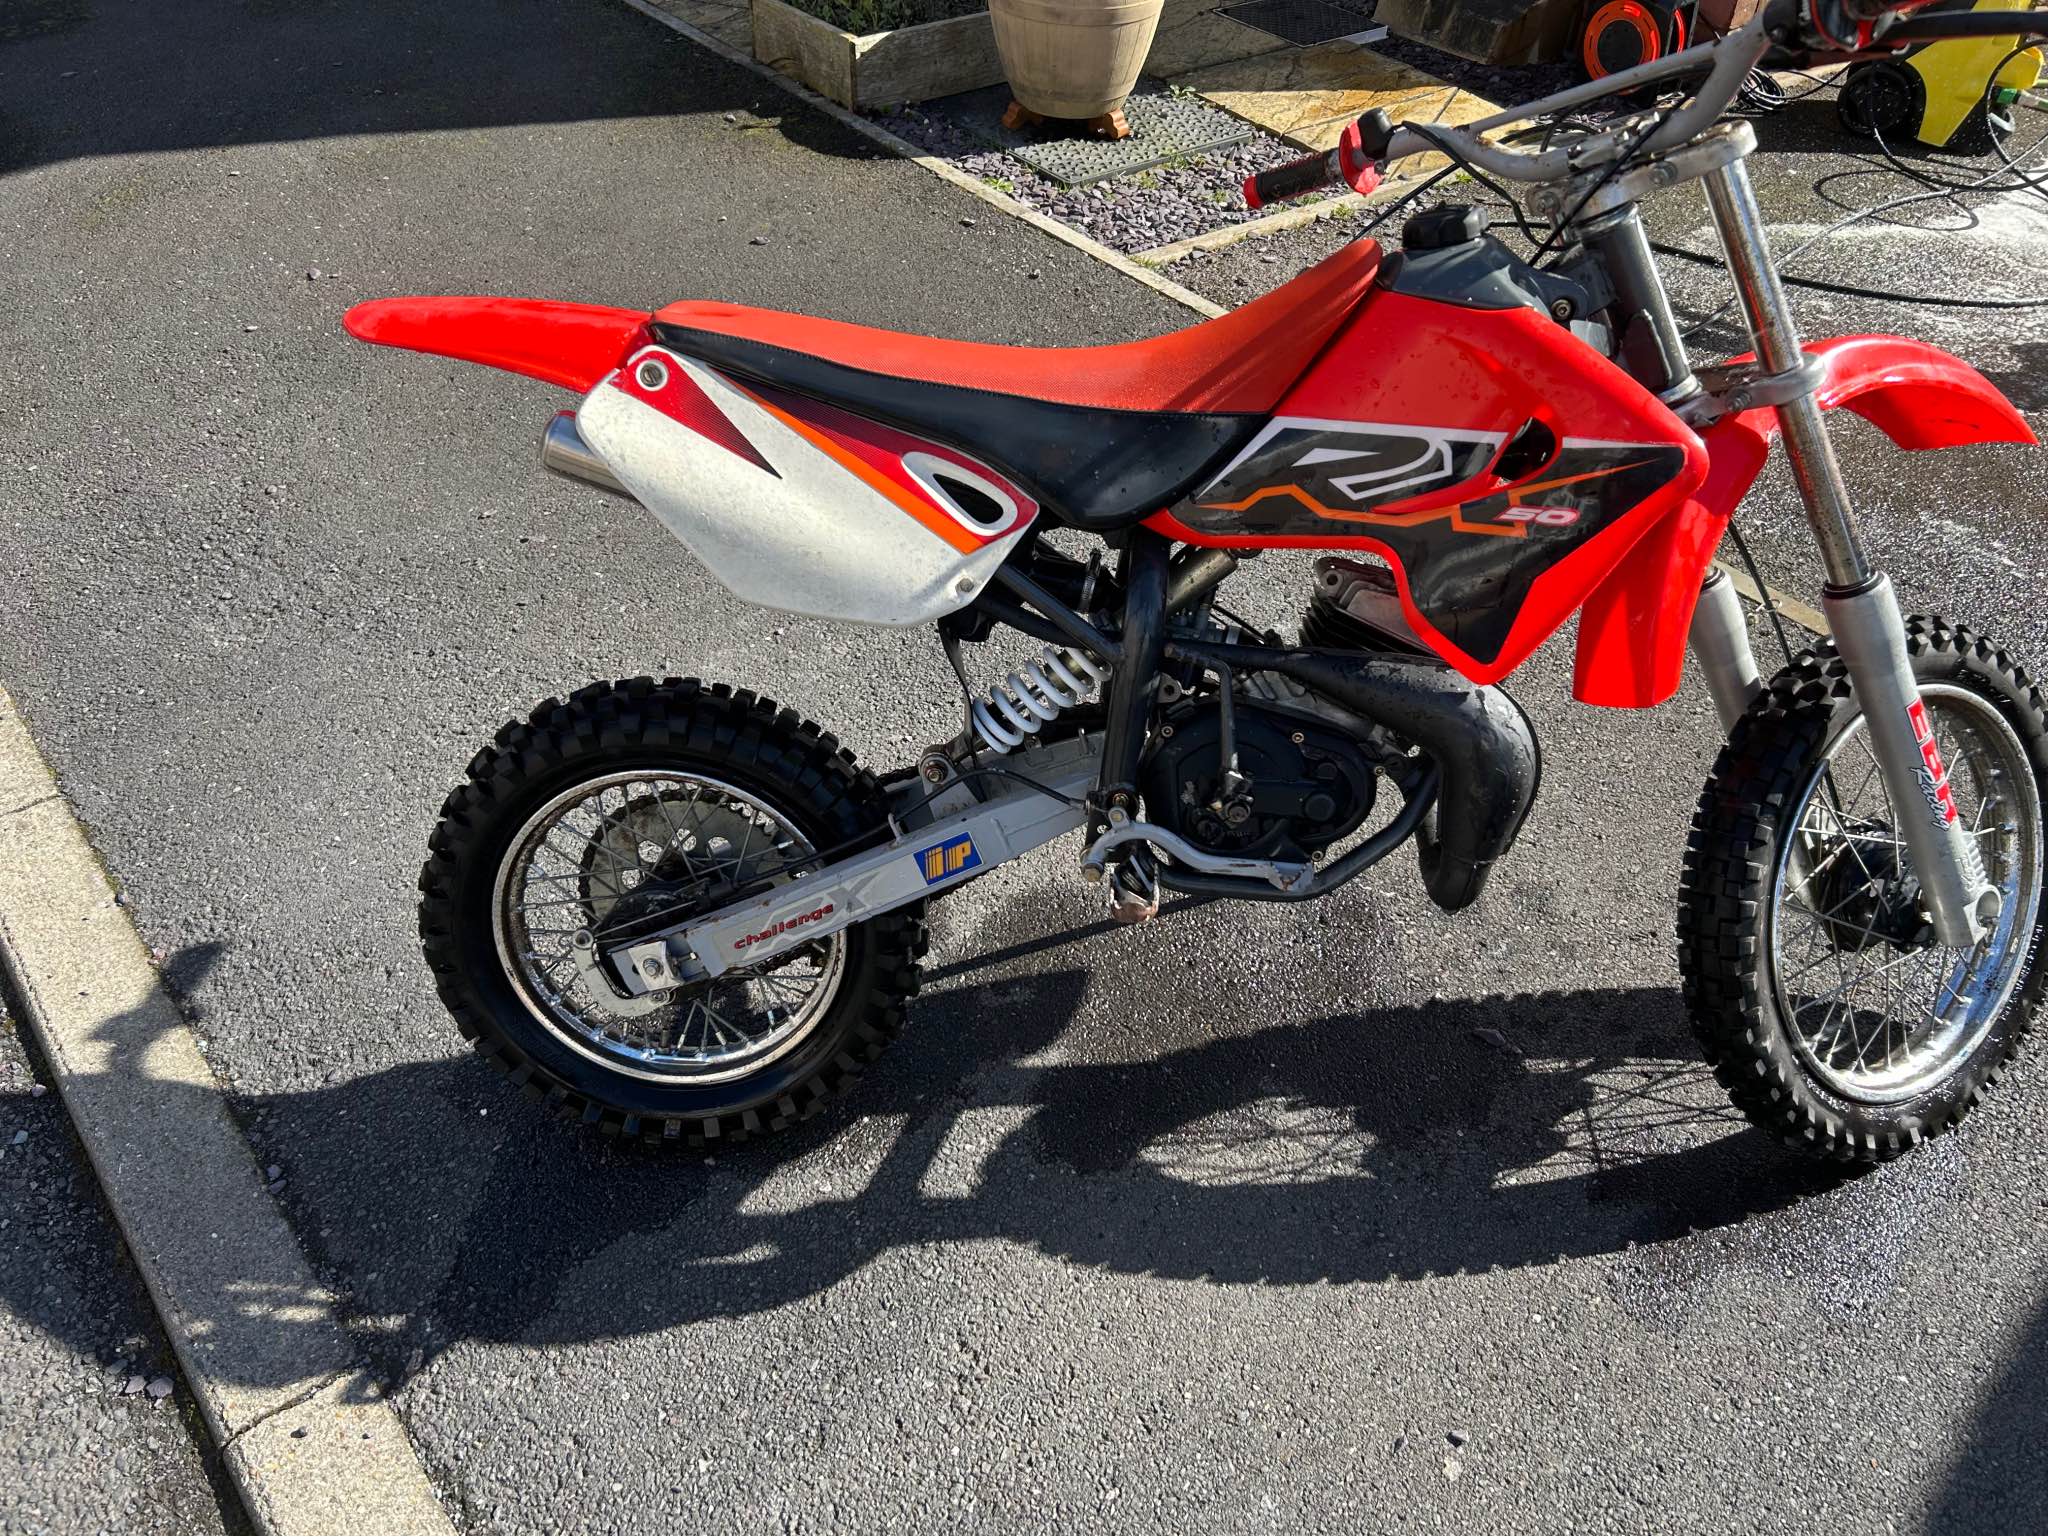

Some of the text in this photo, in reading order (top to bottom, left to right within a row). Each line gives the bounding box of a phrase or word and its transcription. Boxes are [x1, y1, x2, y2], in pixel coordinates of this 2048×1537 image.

[1494, 505, 1580, 526] 50
[1909, 765, 1951, 831] Racing
[734, 904, 833, 950] challenge
